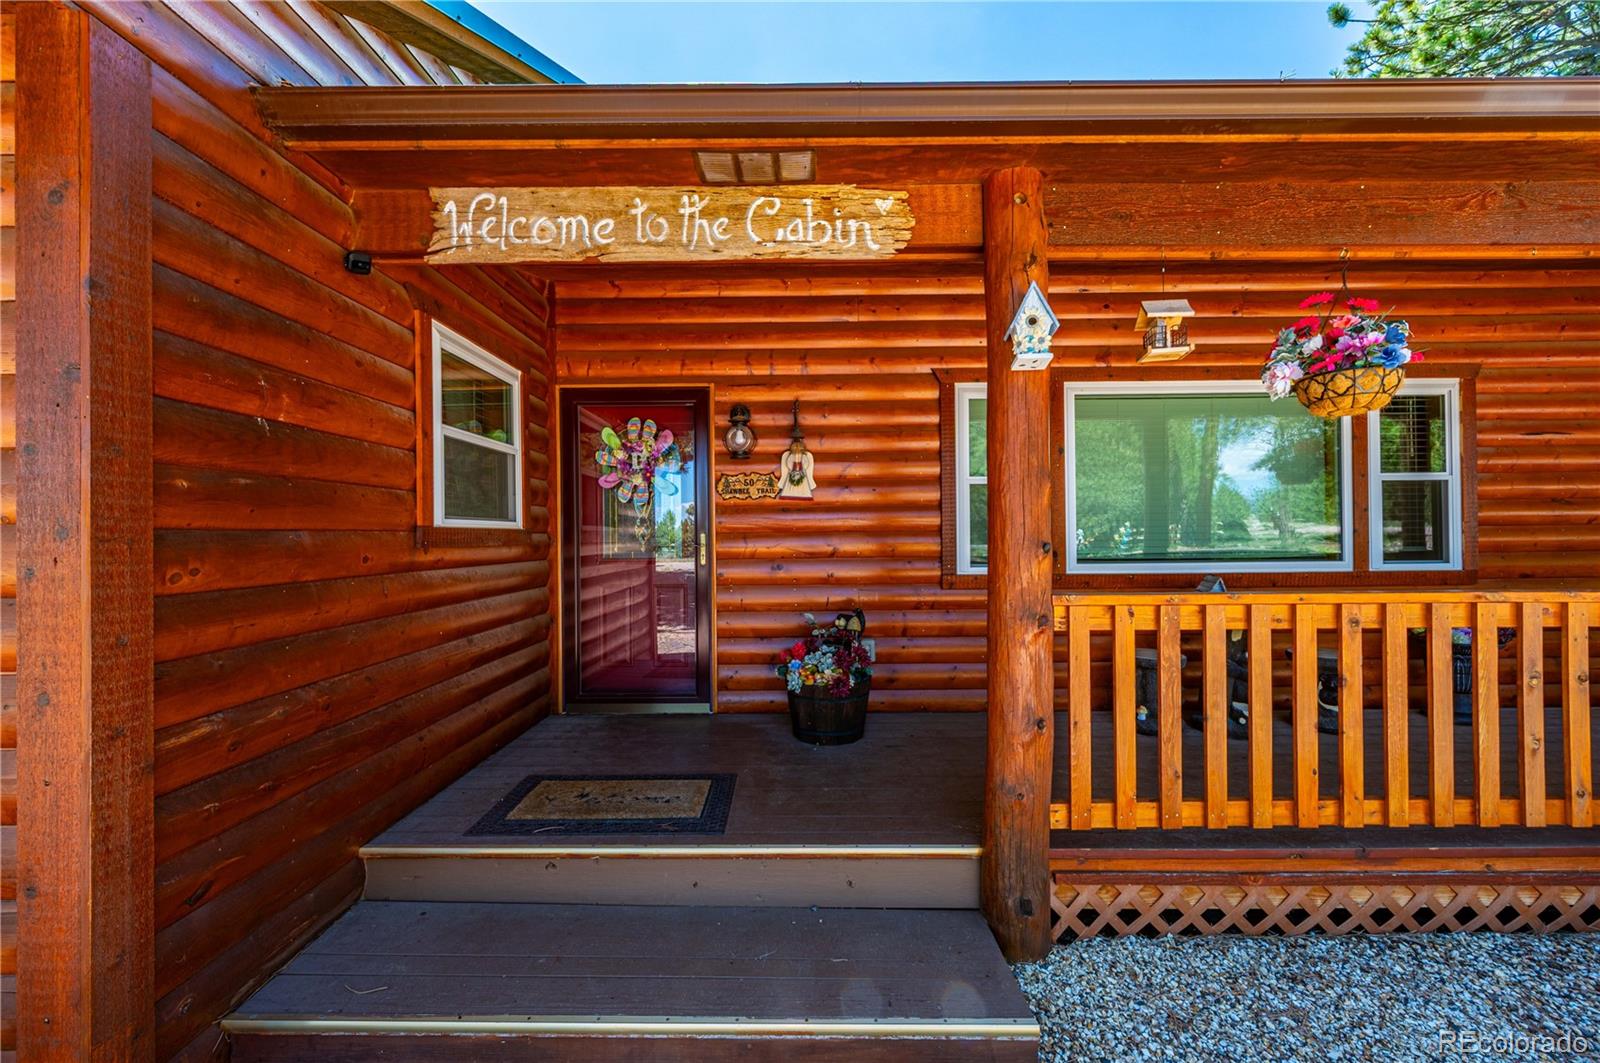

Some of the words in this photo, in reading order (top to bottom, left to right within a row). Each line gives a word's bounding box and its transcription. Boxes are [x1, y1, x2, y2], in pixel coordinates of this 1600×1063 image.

[443, 192, 616, 253] Welcome
[629, 197, 668, 244] to
[678, 194, 732, 250] the
[745, 196, 881, 250] Cabin
[743, 478, 755, 487] 50
